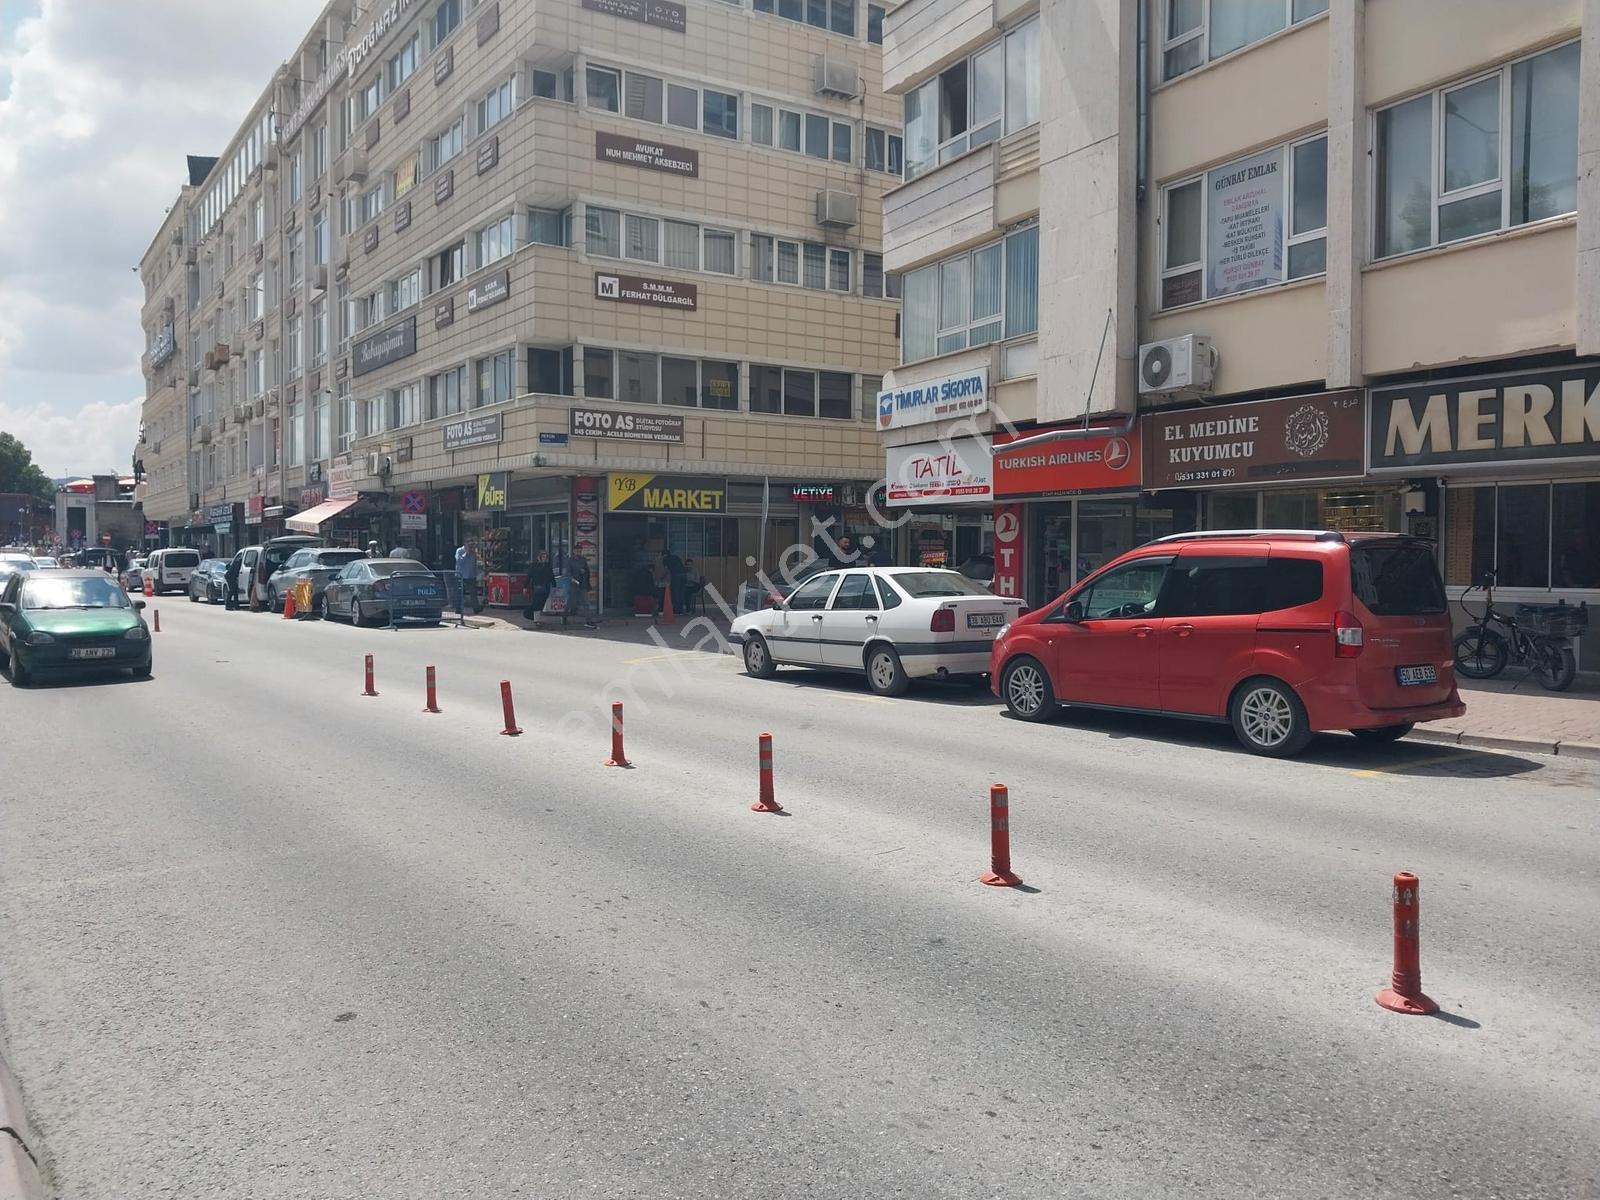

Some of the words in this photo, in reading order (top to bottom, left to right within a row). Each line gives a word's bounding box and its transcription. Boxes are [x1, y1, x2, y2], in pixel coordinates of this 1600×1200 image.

[606, 148, 621, 158] NUH
[622, 151, 653, 164] MEHMET
[635, 144, 664, 156] AVUKAT
[1215, 170, 1246, 191] GÜNBAY
[1248, 162, 1277, 180] EMLAK
[621, 290, 651, 300] FERHAT
[895, 386, 938, 410] TİMURLAR
[941, 375, 983, 400] SİGORTA
[446, 423, 463, 440] FOTO
[463, 421, 473, 437] AS
[574, 411, 612, 429] FOTO
[616, 415, 634, 430] AS
[1164, 425, 1184, 441] EL
[1189, 415, 1259, 438] MEDİNE
[998, 456, 1046, 470] TURKISH
[1048, 450, 1102, 466] AIRLINES
[1169, 441, 1254, 463] KUYUMCU
[911, 450, 962, 479] TATİL
[614, 478, 637, 491] YB
[484, 485, 504, 506] BÜFE
[643, 489, 724, 510] MARKET
